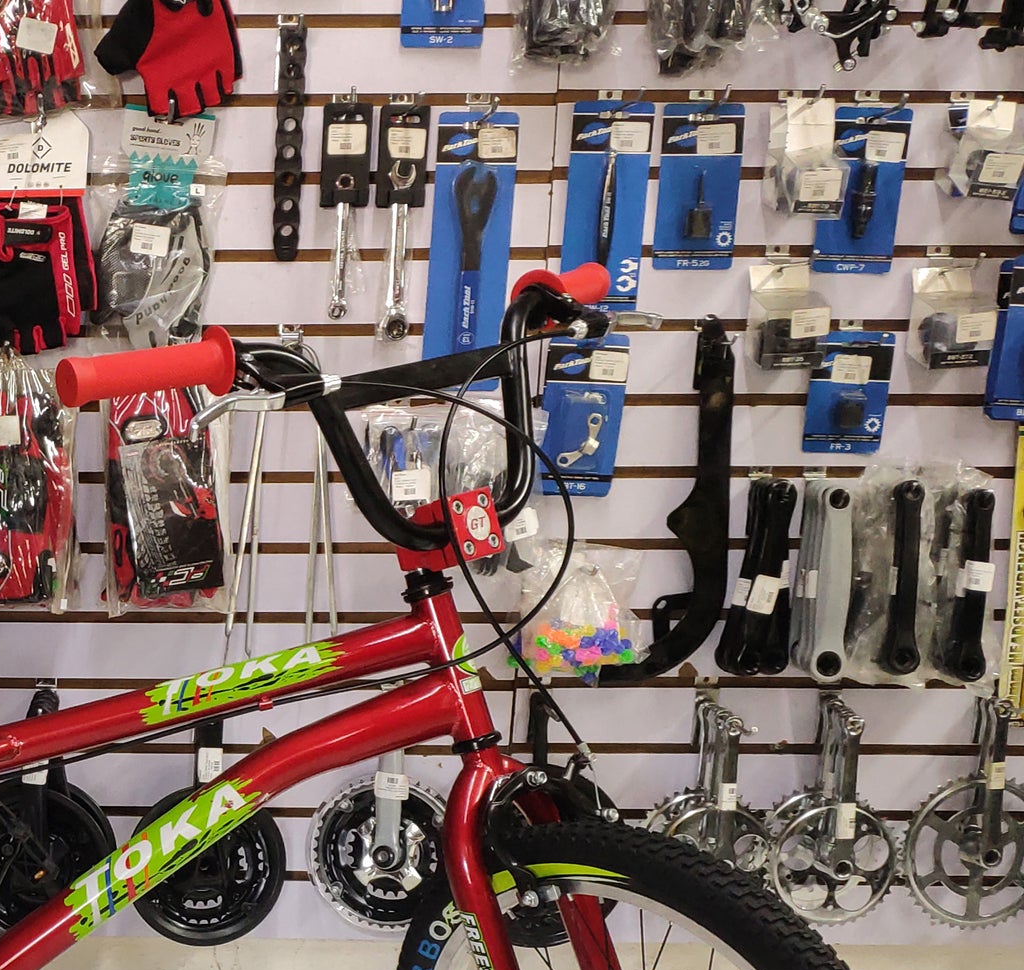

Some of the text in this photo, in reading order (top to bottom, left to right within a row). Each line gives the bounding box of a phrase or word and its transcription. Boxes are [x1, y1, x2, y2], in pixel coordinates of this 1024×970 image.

[429, 35, 454, 44] SW-2
[7, 162, 73, 174] DOLOMITE
[58, 231, 70, 271] GEL PRO
[829, 442, 852, 451] FR-3
[470, 515, 486, 531] GT
[160, 645, 324, 717] TOKA
[75, 783, 247, 927] TOKA
